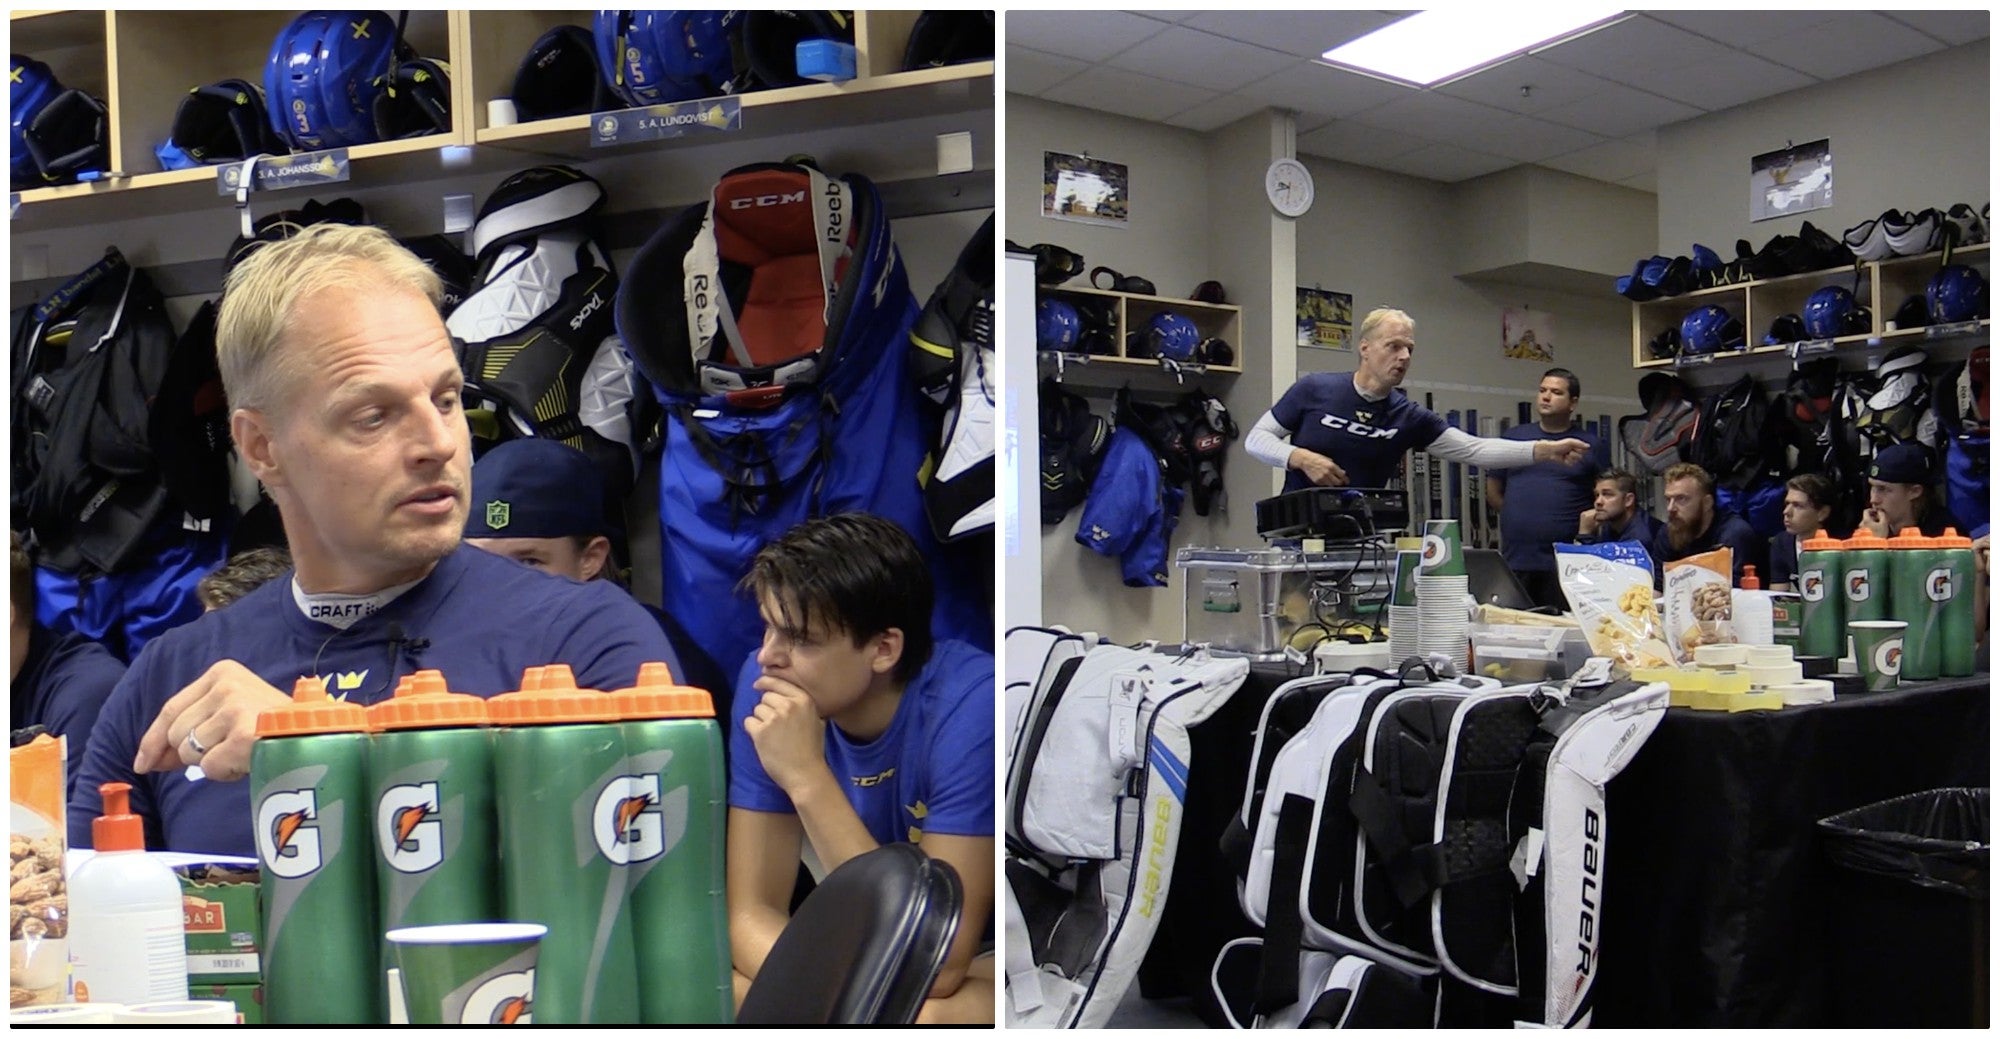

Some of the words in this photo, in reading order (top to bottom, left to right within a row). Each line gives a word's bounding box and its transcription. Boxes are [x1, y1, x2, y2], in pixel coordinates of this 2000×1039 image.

[630, 63, 645, 83] 5
[296, 113, 310, 133] 3
[639, 119, 647, 129] 5.
[649, 117, 657, 128] A.
[660, 112, 713, 127] LUNDQVIST
[267, 168, 276, 178] A.
[277, 161, 327, 177] JOHANSSON
[729, 190, 806, 210] CCM
[569, 292, 604, 330] TACKS
[1320, 413, 1399, 440] CCM
[1800, 569, 1825, 602] G
[1844, 568, 1870, 602] G
[1925, 567, 1952, 602] G
[310, 604, 363, 618] CRAFT
[1874, 638, 1903, 677] G
[258, 787, 323, 880] G
[377, 780, 445, 875] G
[592, 772, 665, 866] G
